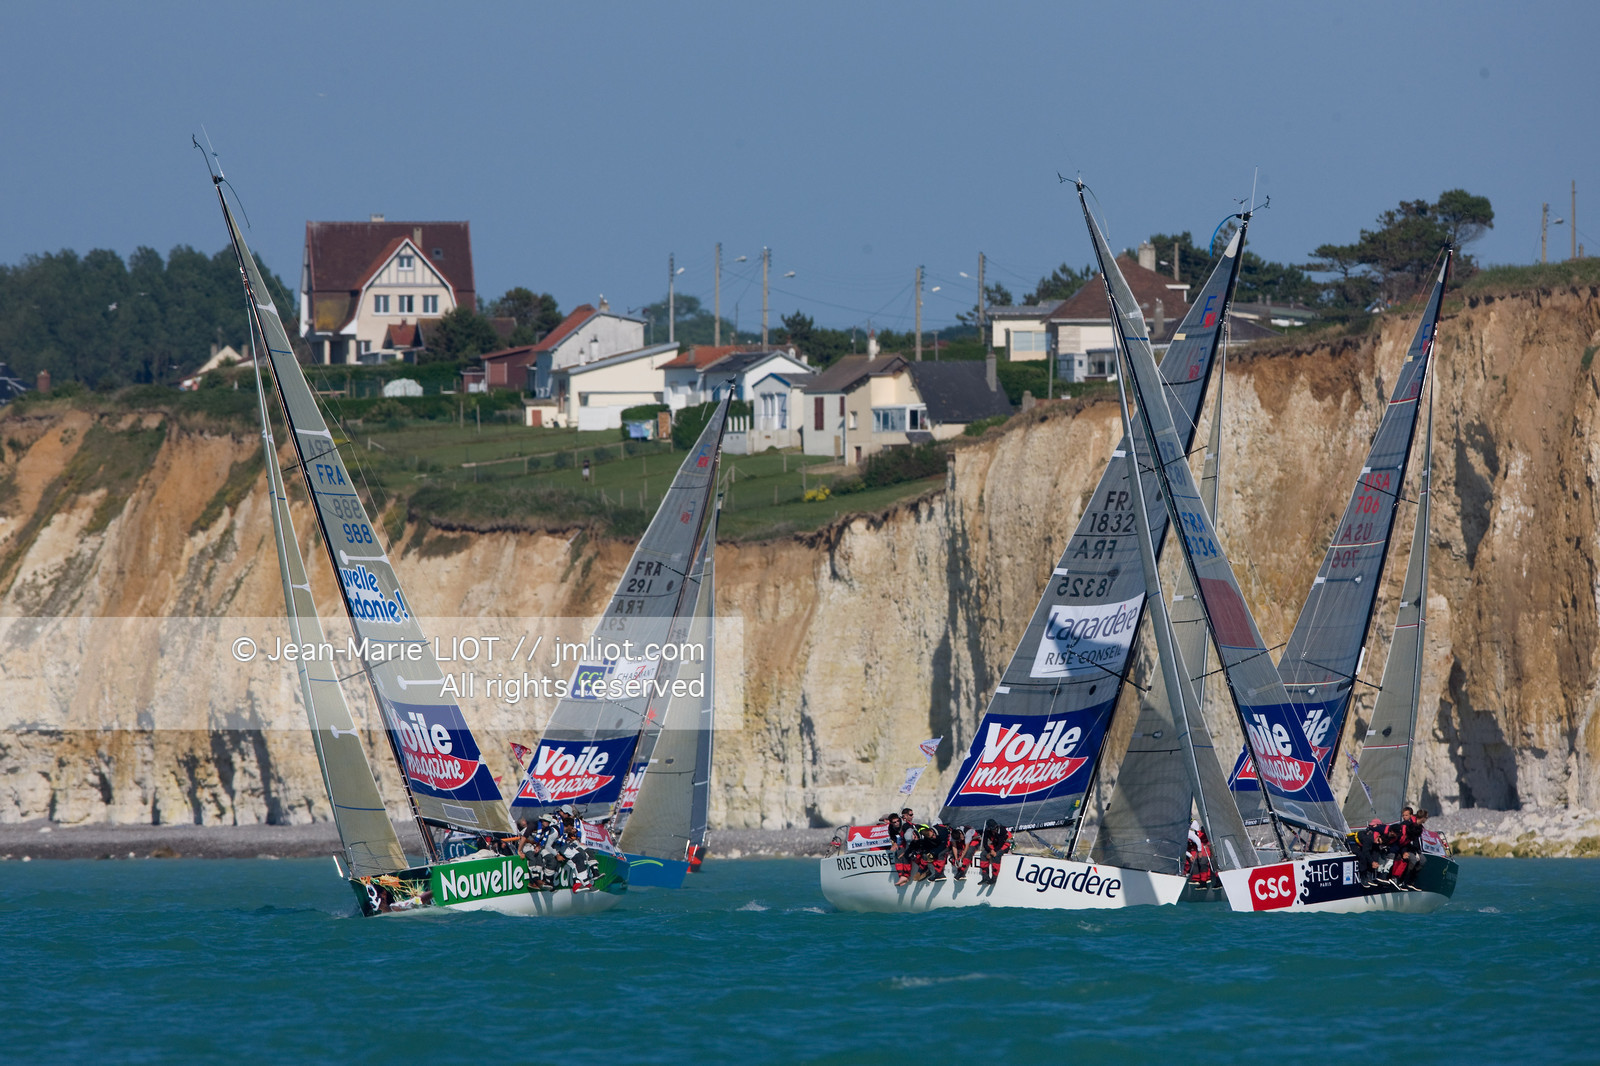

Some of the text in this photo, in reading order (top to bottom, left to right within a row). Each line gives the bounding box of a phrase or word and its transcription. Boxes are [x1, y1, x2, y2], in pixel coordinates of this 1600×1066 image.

[316, 464, 346, 486] FRA
[1364, 472, 1391, 492] USA
[1355, 496, 1381, 514] 706
[342, 523, 373, 544] 988
[1089, 513, 1138, 533] 1832
[1181, 512, 1207, 533] FRA
[634, 561, 661, 576] FRA
[1045, 604, 1138, 645] Lagardère
[1045, 644, 1121, 665] RISE CONSEIL
[1302, 709, 1331, 746] ile
[982, 720, 1081, 763] Voile
[405, 752, 464, 791] magazine
[534, 746, 609, 777] Voile
[527, 775, 600, 802] magazine
[970, 757, 1068, 798] magazine
[837, 852, 897, 871] RISE CONSE
[1309, 862, 1339, 883] HEC
[1015, 857, 1121, 898] Lagardère
[1254, 876, 1292, 900] CSC
